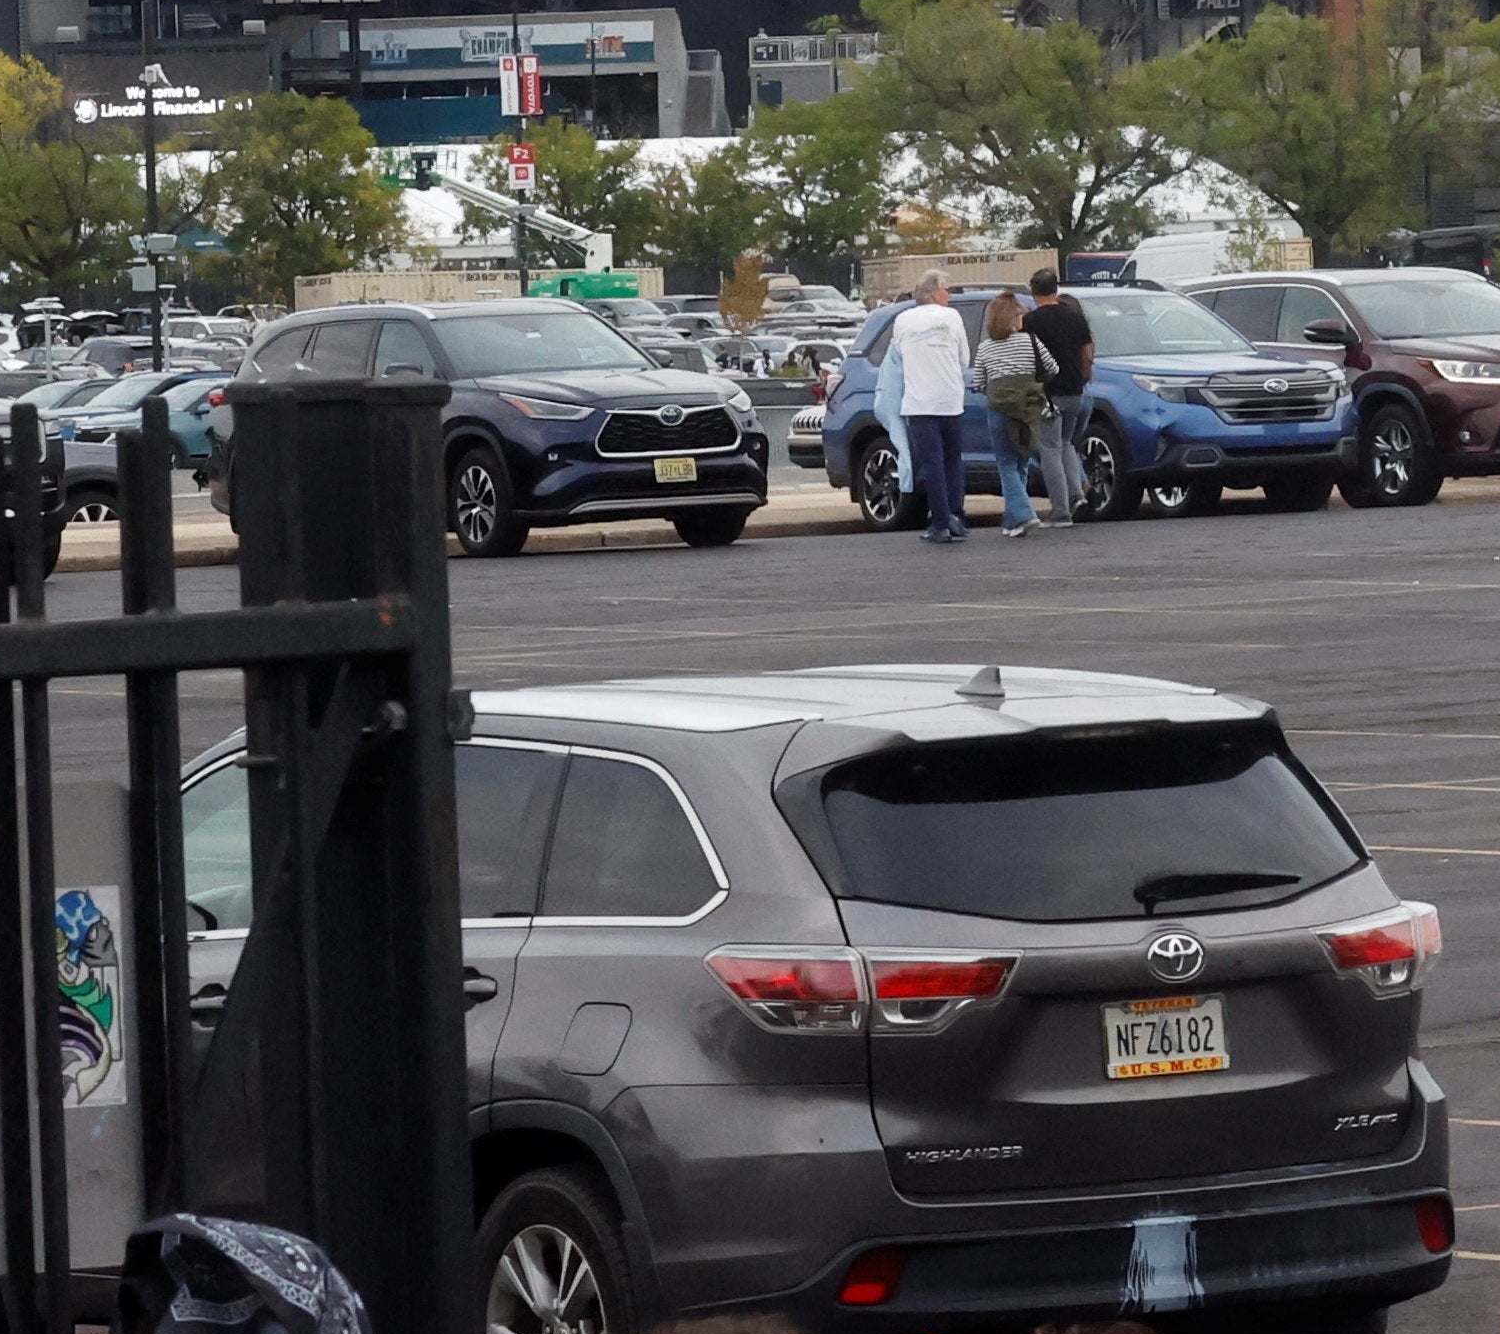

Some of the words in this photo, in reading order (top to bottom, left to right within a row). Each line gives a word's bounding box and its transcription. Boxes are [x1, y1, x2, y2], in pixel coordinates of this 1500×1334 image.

[125, 86, 184, 100] Wecome
[185, 85, 200, 98] to
[527, 73, 537, 115] TOYOTA
[101, 101, 146, 118] Lincol
[153, 99, 216, 116] Financial
[513, 147, 530, 160] F2
[1131, 997, 1193, 1011] VETERAN
[1116, 1015, 1215, 1057] NFZ6182
[1334, 1114, 1370, 1132] XLE
[905, 1145, 1023, 1165] HIGHLANDER
